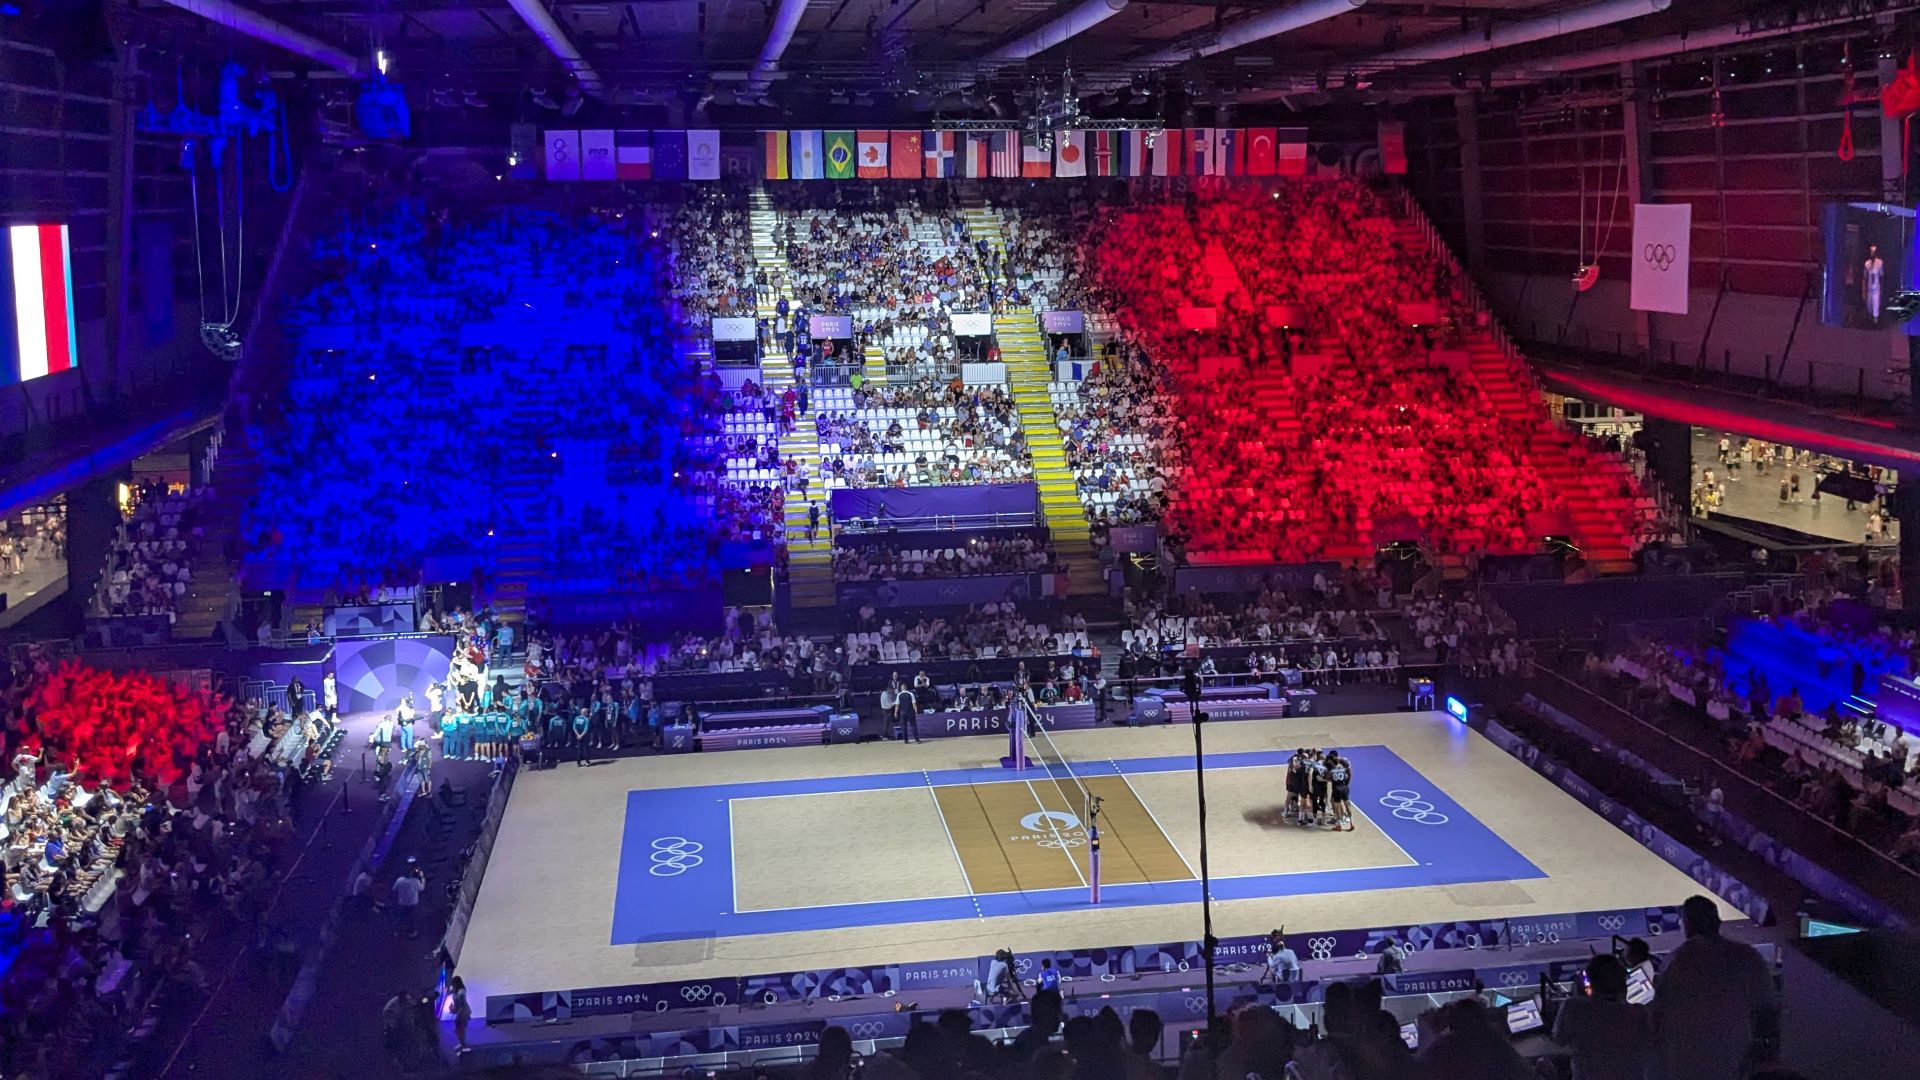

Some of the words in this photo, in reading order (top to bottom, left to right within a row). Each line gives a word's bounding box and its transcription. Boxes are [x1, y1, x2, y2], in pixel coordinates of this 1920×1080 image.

[1228, 710, 1250, 718] 2024
[946, 716, 1000, 731] PARIS
[737, 738, 762, 746] PARIS
[764, 737, 786, 745] 2024
[1010, 833, 1057, 841] PARIS
[1511, 924, 1541, 934] PARIS
[1544, 922, 1571, 931] 2024
[1216, 945, 1248, 956] PARIS
[906, 970, 939, 980] PARIS
[942, 968, 972, 978] 2024
[1404, 981, 1437, 991] PARIS
[1440, 979, 1471, 989] 2024
[578, 996, 613, 1007] PARIS
[616, 993, 649, 1005] 2024
[745, 1034, 782, 1046] PARIS
[785, 1031, 819, 1042] 2024
